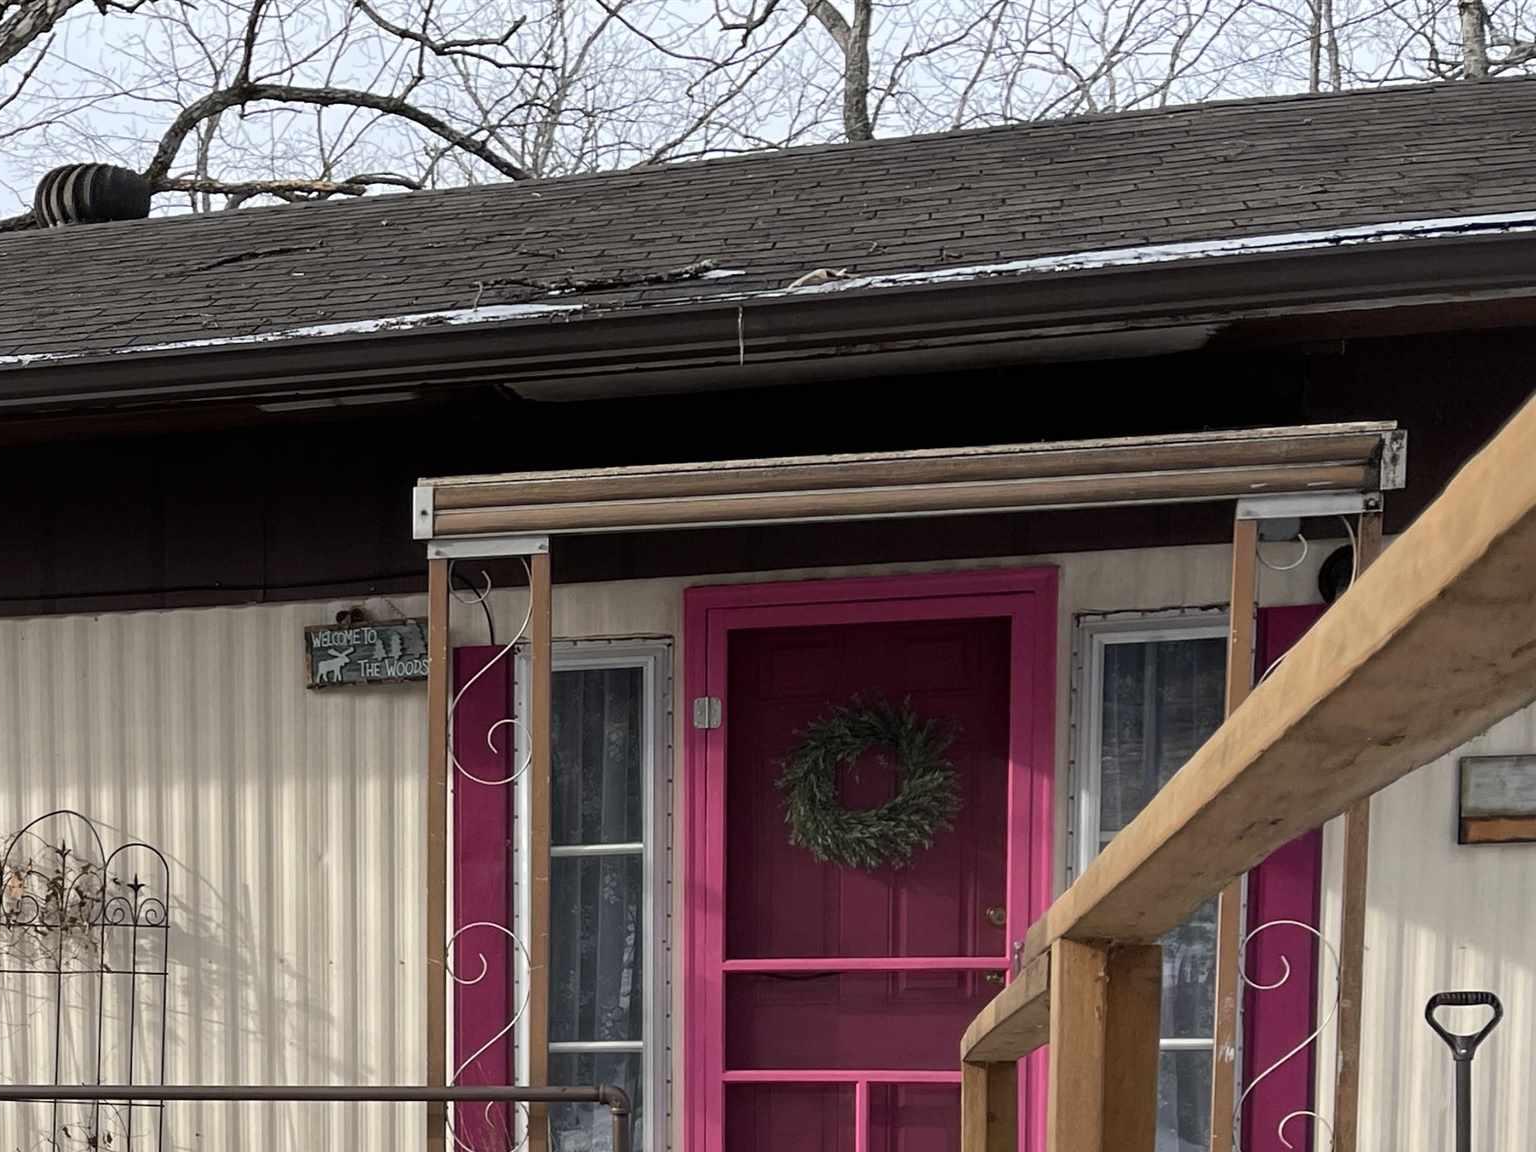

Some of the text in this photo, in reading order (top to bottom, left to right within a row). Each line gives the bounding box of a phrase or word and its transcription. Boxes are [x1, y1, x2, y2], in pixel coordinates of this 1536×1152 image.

[312, 627, 378, 647] WELCOME TO
[358, 658, 430, 678] THE WOODS
